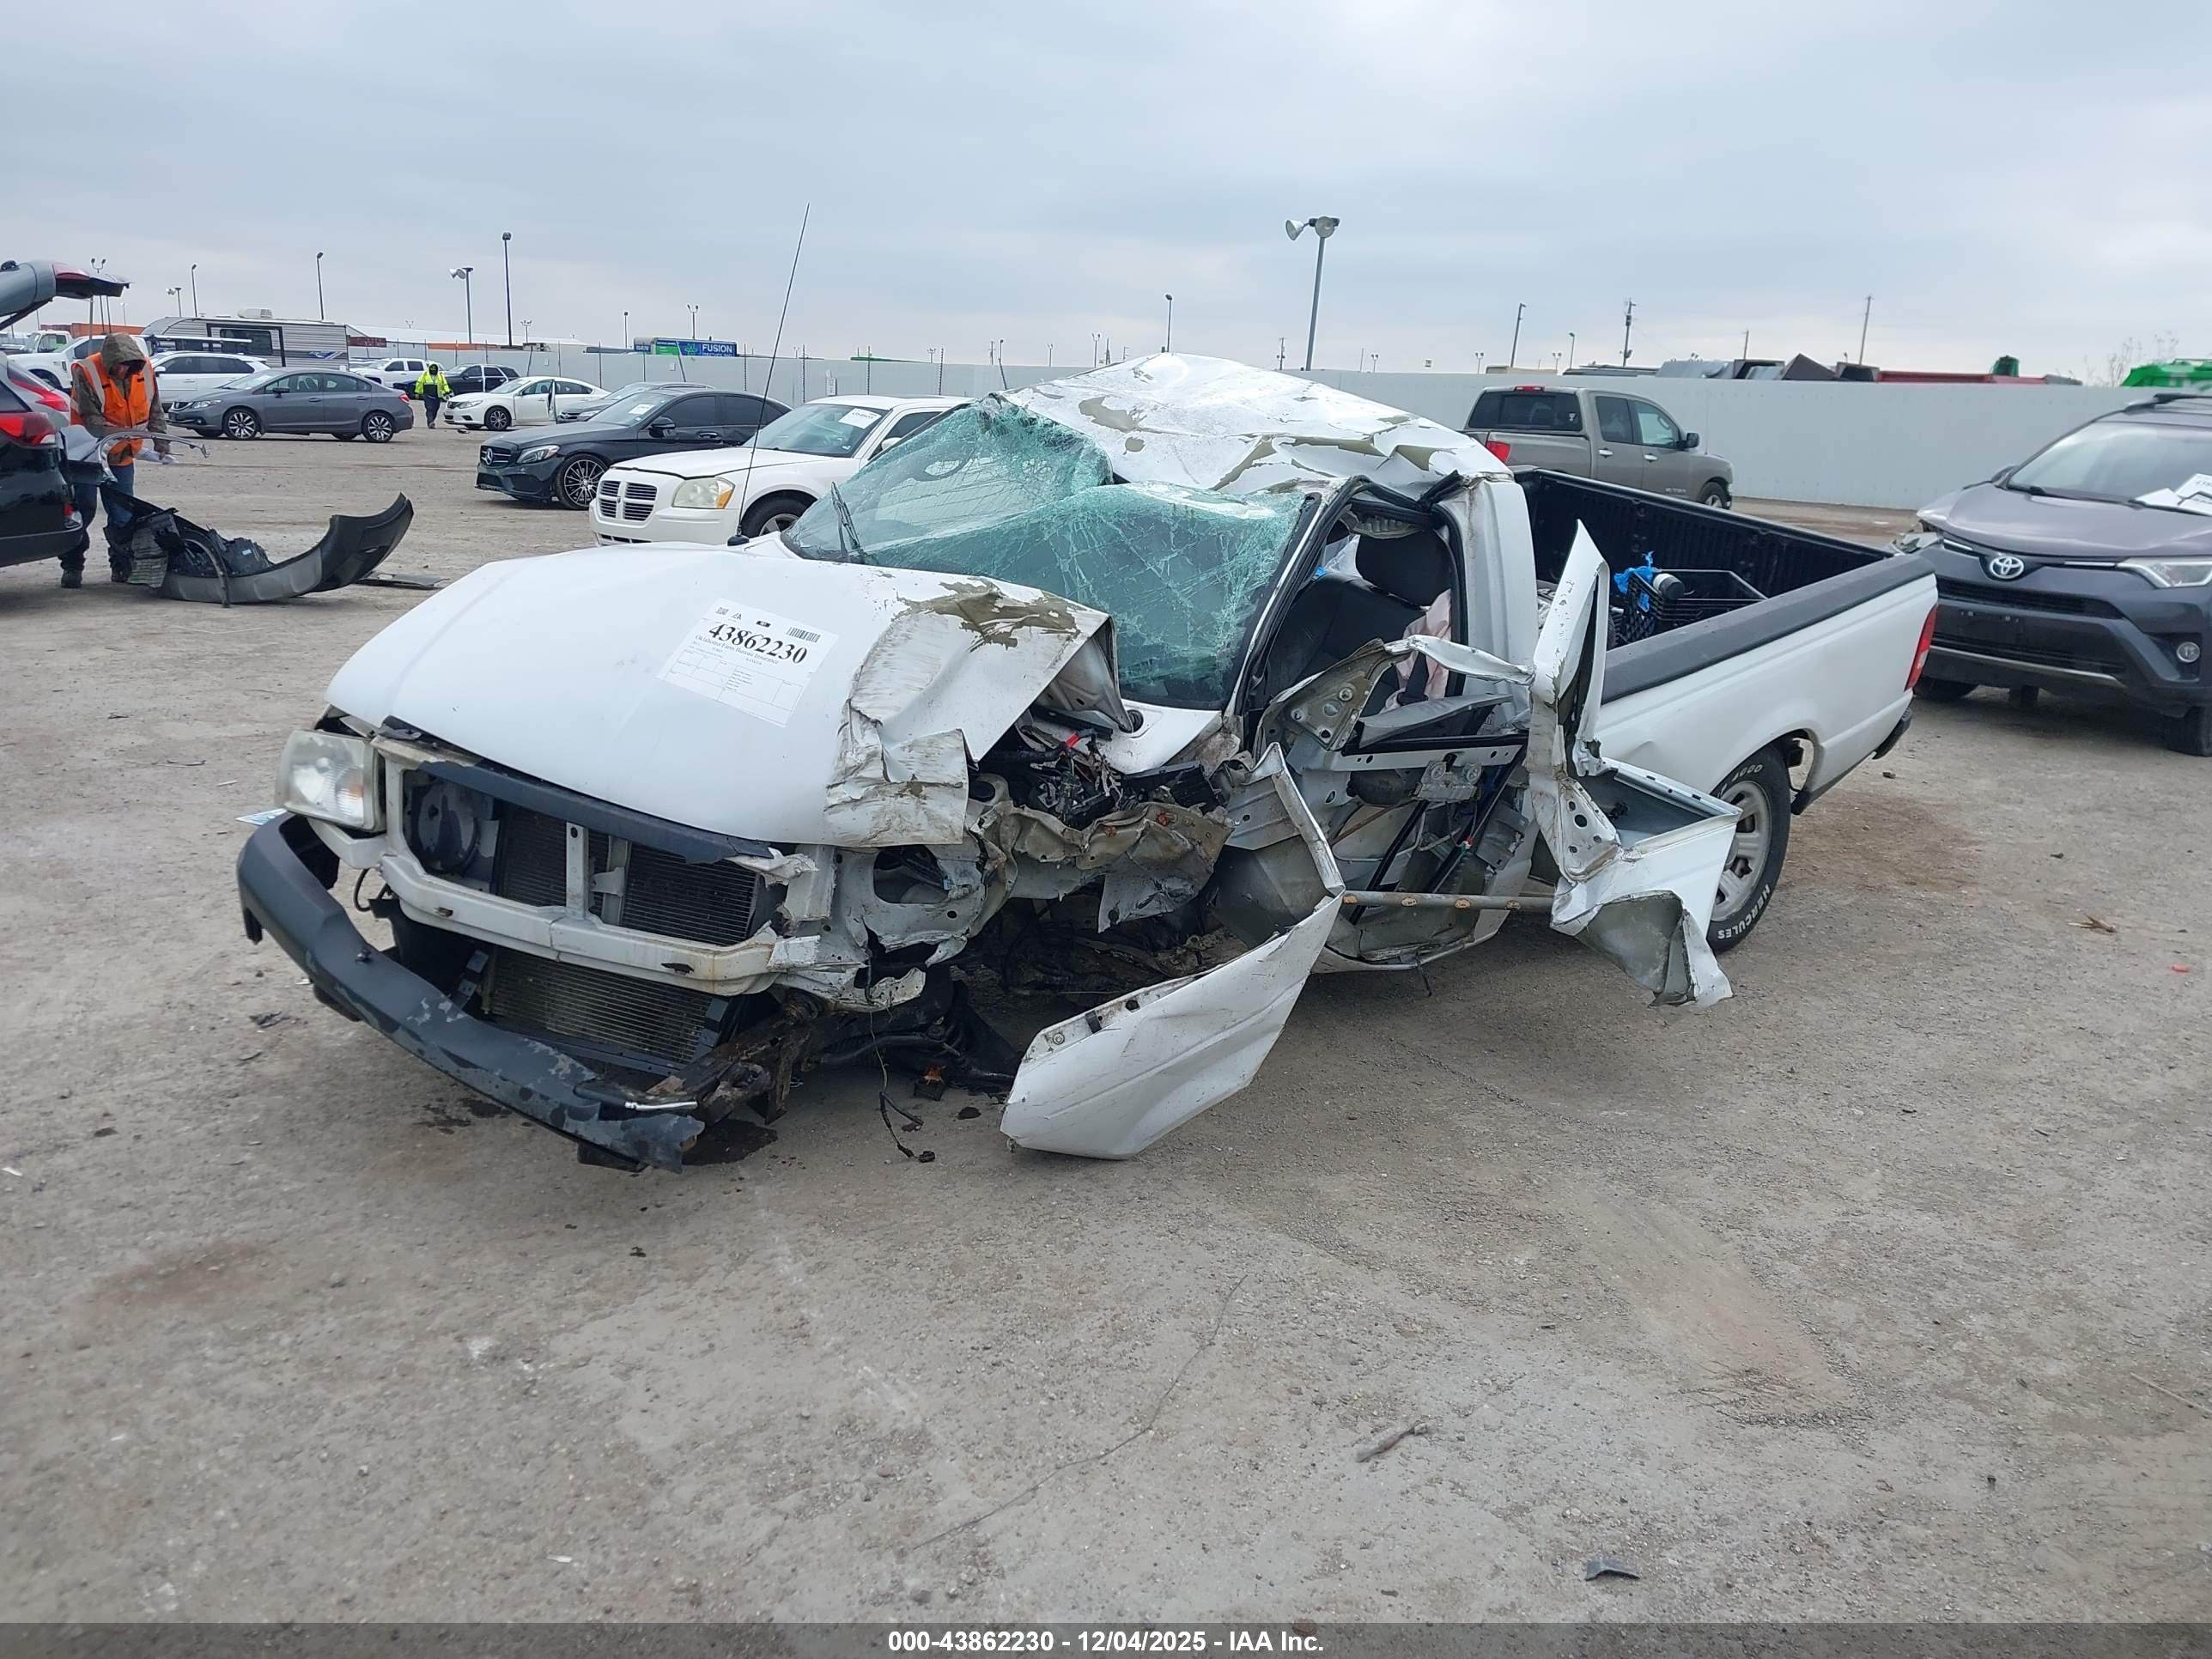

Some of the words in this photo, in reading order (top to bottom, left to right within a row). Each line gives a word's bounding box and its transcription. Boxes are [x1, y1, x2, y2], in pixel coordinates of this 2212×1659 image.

[702, 343, 732, 353] FUSION
[708, 623, 808, 664] 43862230
[1717, 884, 1771, 939] HERCULES
